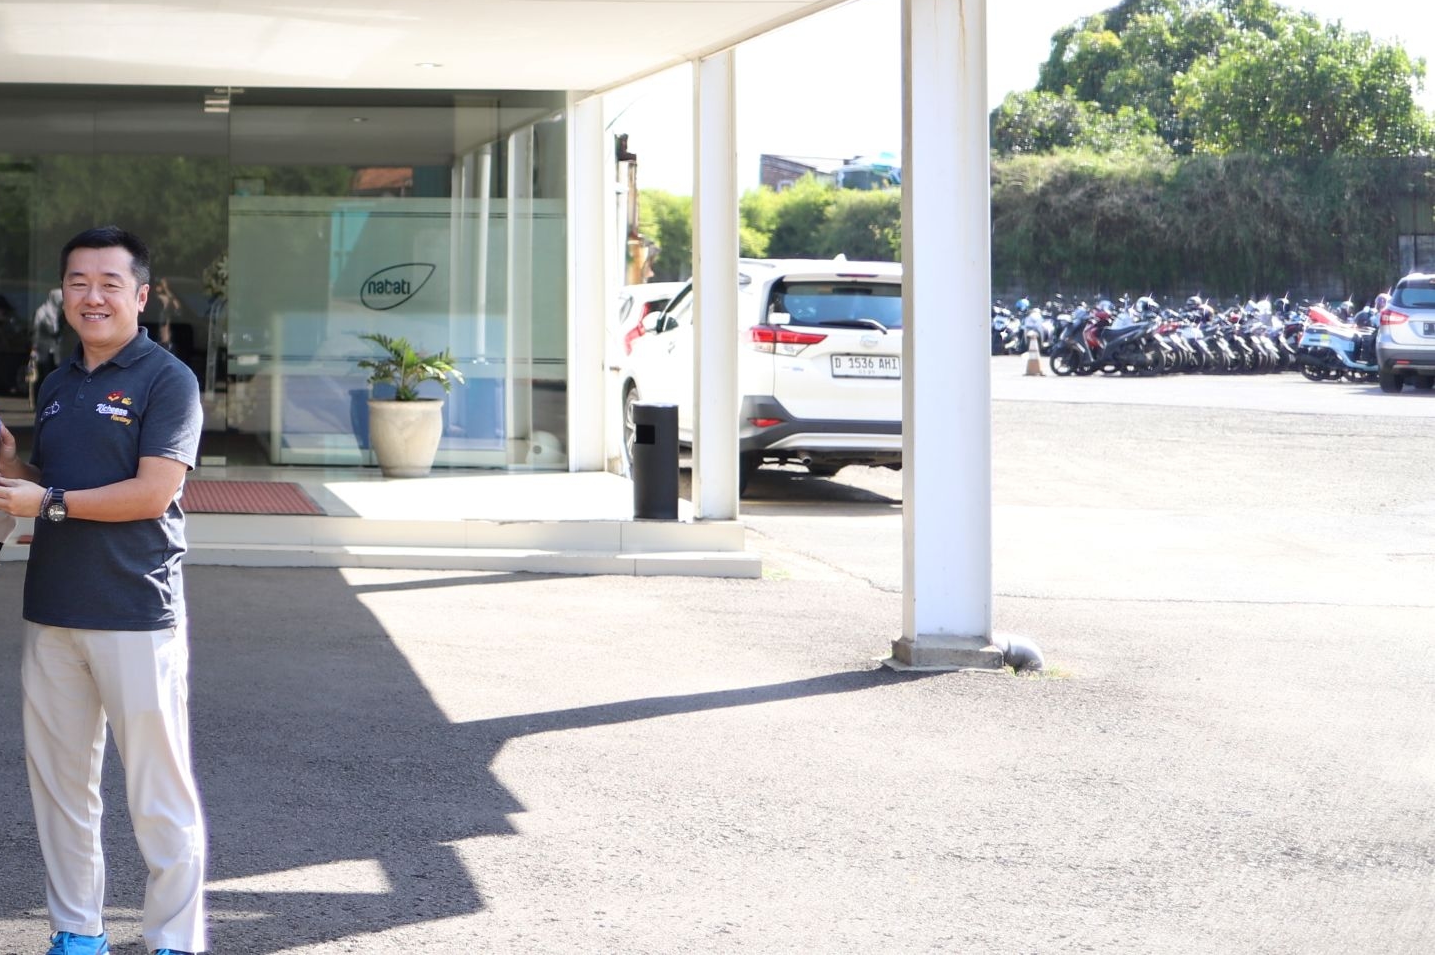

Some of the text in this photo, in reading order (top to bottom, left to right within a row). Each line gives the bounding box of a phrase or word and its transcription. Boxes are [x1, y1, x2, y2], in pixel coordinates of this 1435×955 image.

[368, 278, 411, 295] nabati
[834, 357, 898, 370] D 1536 AHI
